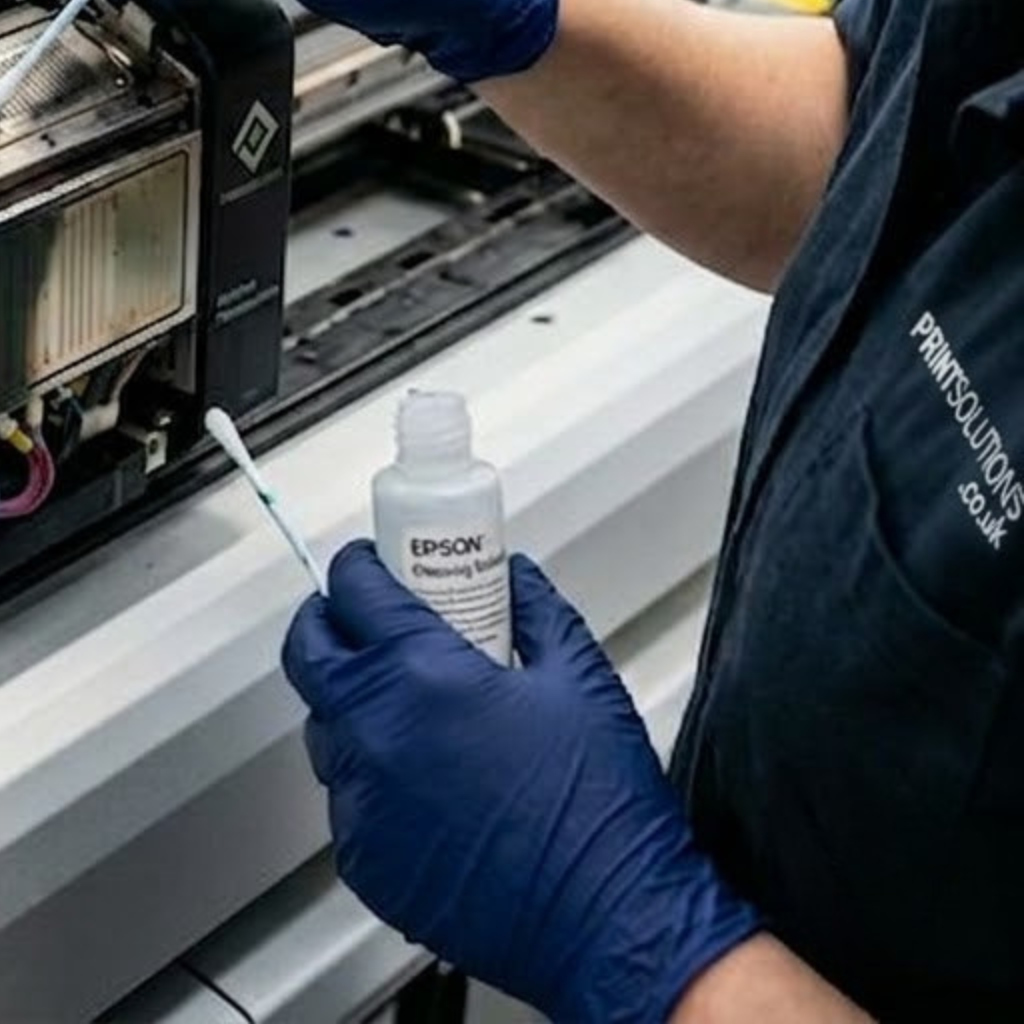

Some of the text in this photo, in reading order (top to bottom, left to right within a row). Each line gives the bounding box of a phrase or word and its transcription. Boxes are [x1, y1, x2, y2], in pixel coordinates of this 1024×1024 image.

[909, 311, 1024, 521] PRINTSOLUTIONS
[411, 536, 482, 557] EPSON
[957, 481, 1008, 551] .co.uk
